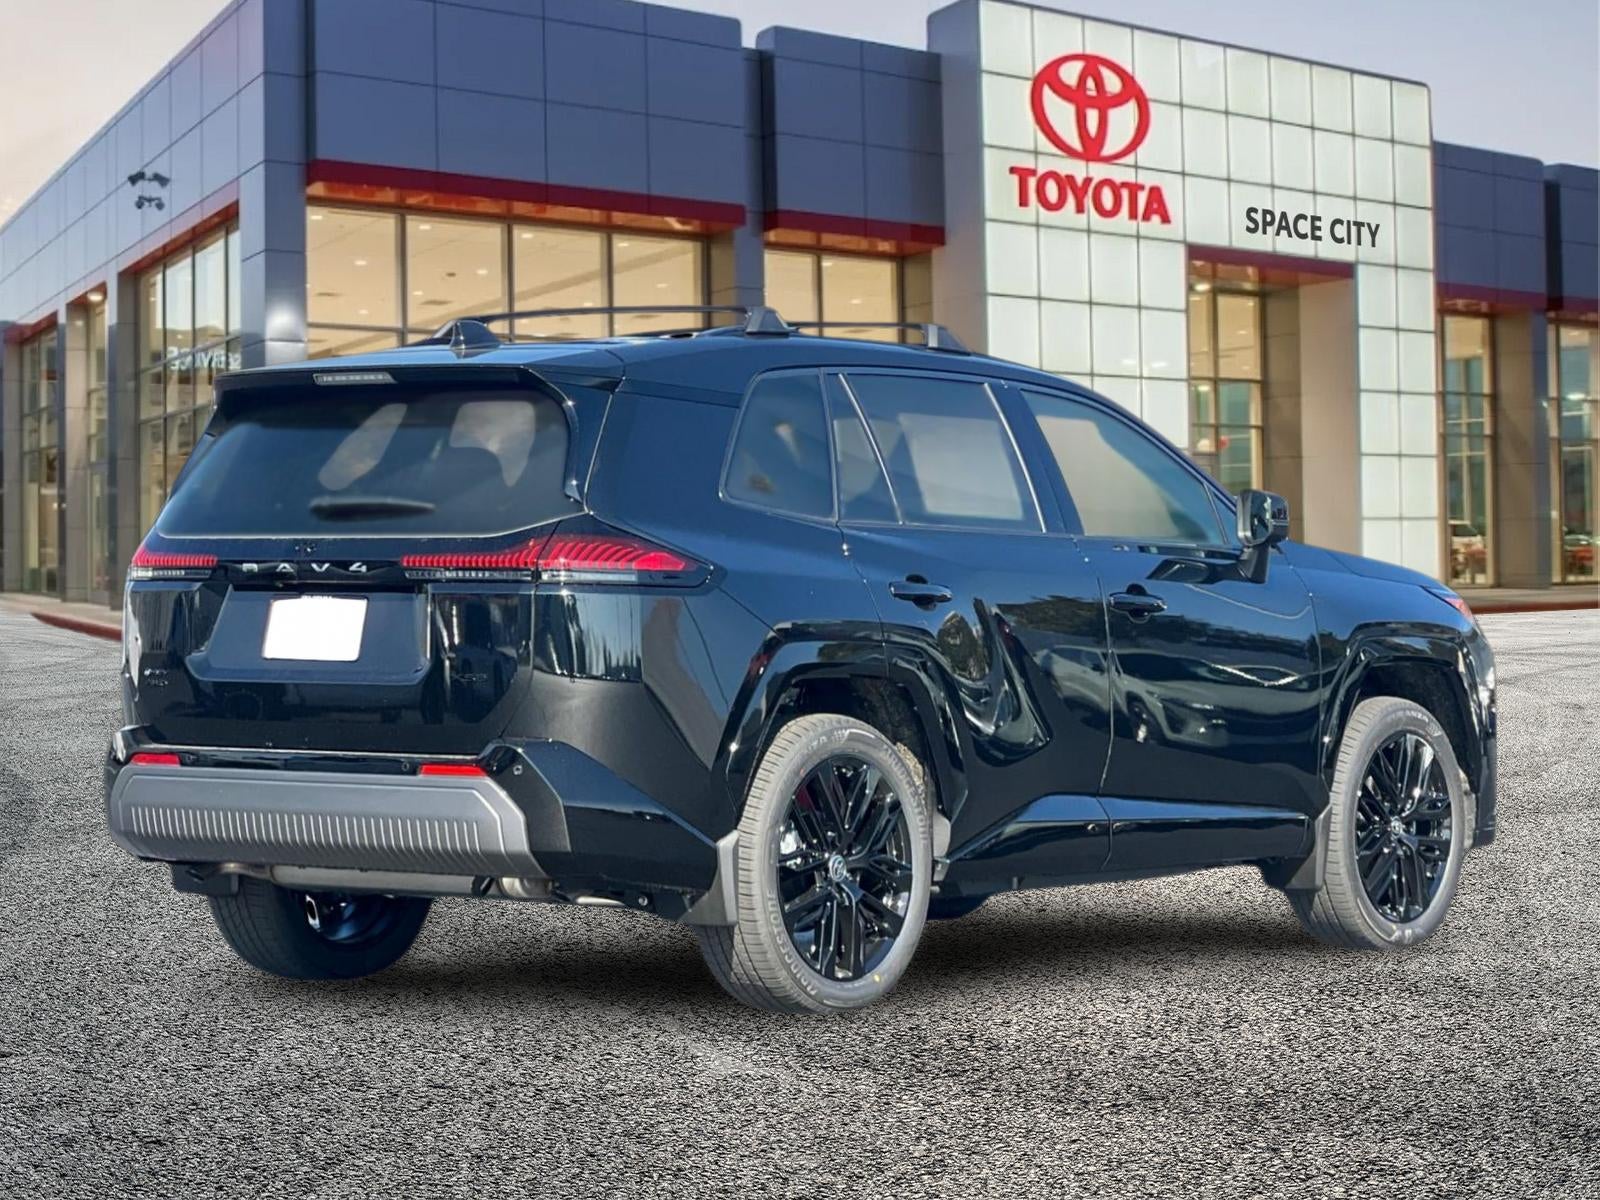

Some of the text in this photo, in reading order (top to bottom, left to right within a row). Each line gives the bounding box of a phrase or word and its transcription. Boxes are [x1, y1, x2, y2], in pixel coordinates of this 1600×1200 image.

[1009, 166, 1171, 224] TOYOTA
[1245, 206, 1381, 248] SPACE CITY
[242, 561, 368, 574] RAV4
